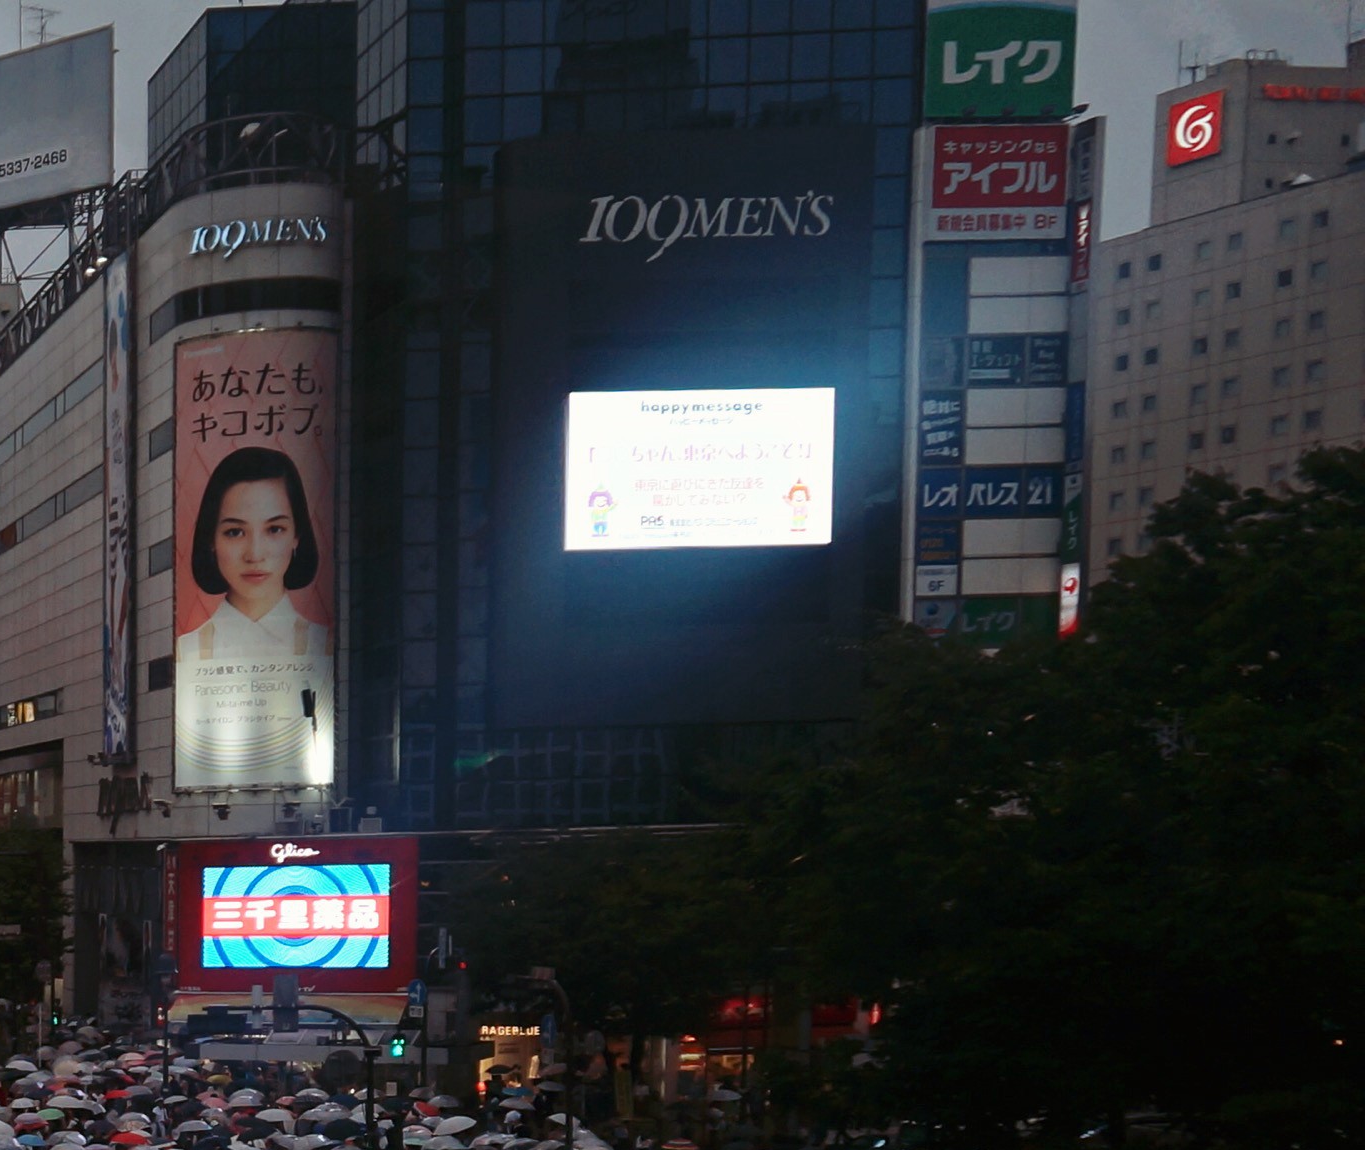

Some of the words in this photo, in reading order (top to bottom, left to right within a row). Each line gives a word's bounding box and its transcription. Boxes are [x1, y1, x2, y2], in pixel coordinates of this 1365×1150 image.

[942, 40, 1062, 84] レイク
[942, 139, 1057, 154] キャッシングなら
[942, 161, 1057, 195] アイフル
[936, 213, 1027, 232] 新規会員募集中
[195, 682, 248, 696] Panasonic
[250, 679, 292, 695] Beauty
[212, 898, 380, 931] 三千里薬品
